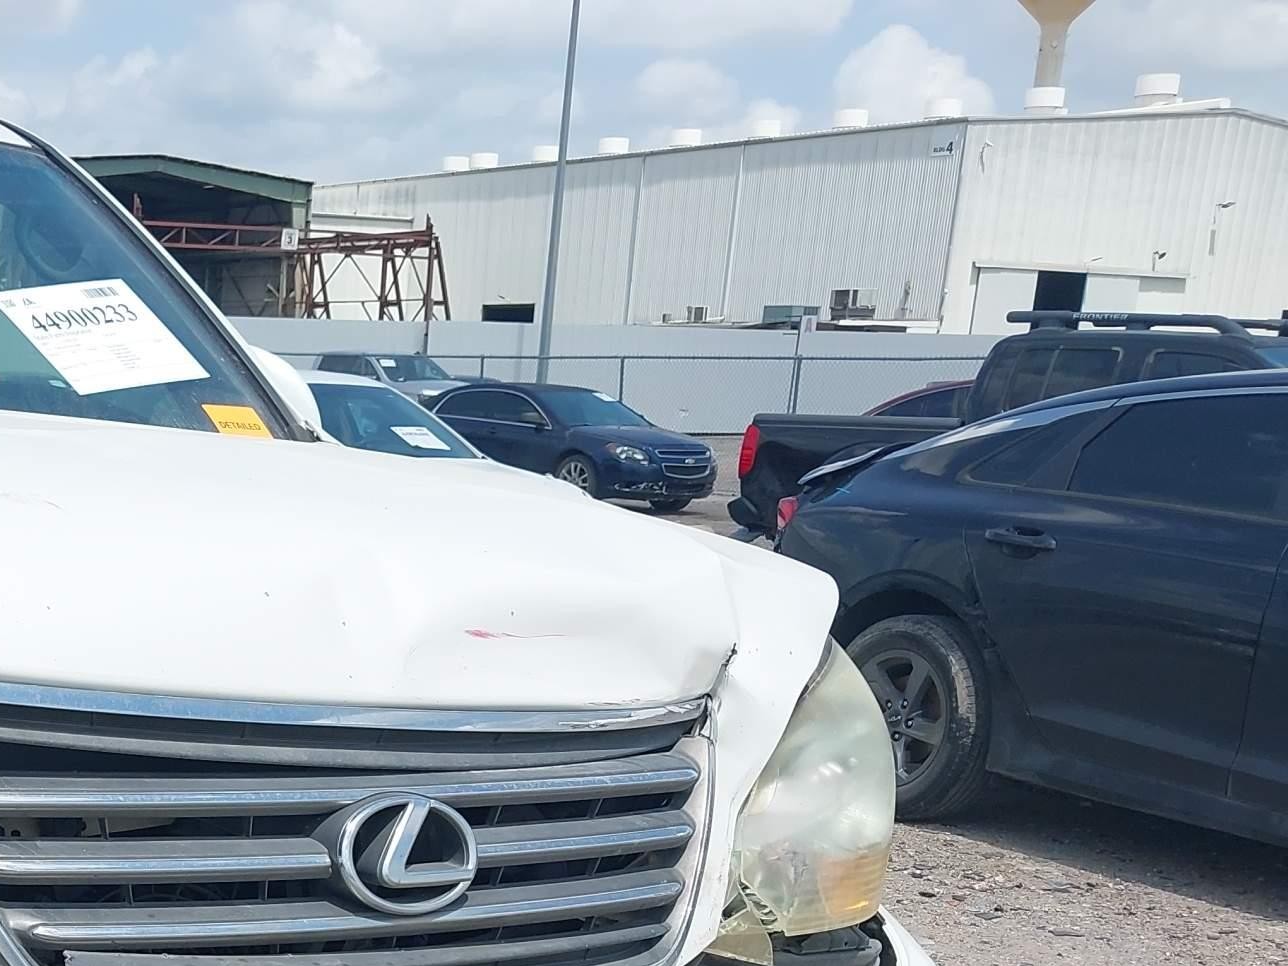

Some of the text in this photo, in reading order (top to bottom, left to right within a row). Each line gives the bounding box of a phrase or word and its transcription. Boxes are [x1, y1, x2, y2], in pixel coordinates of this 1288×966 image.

[945, 140, 954, 154] 4
[31, 303, 138, 332] 44900233
[1072, 312, 1129, 321] FRONTIER
[218, 420, 262, 431] DETAILED
